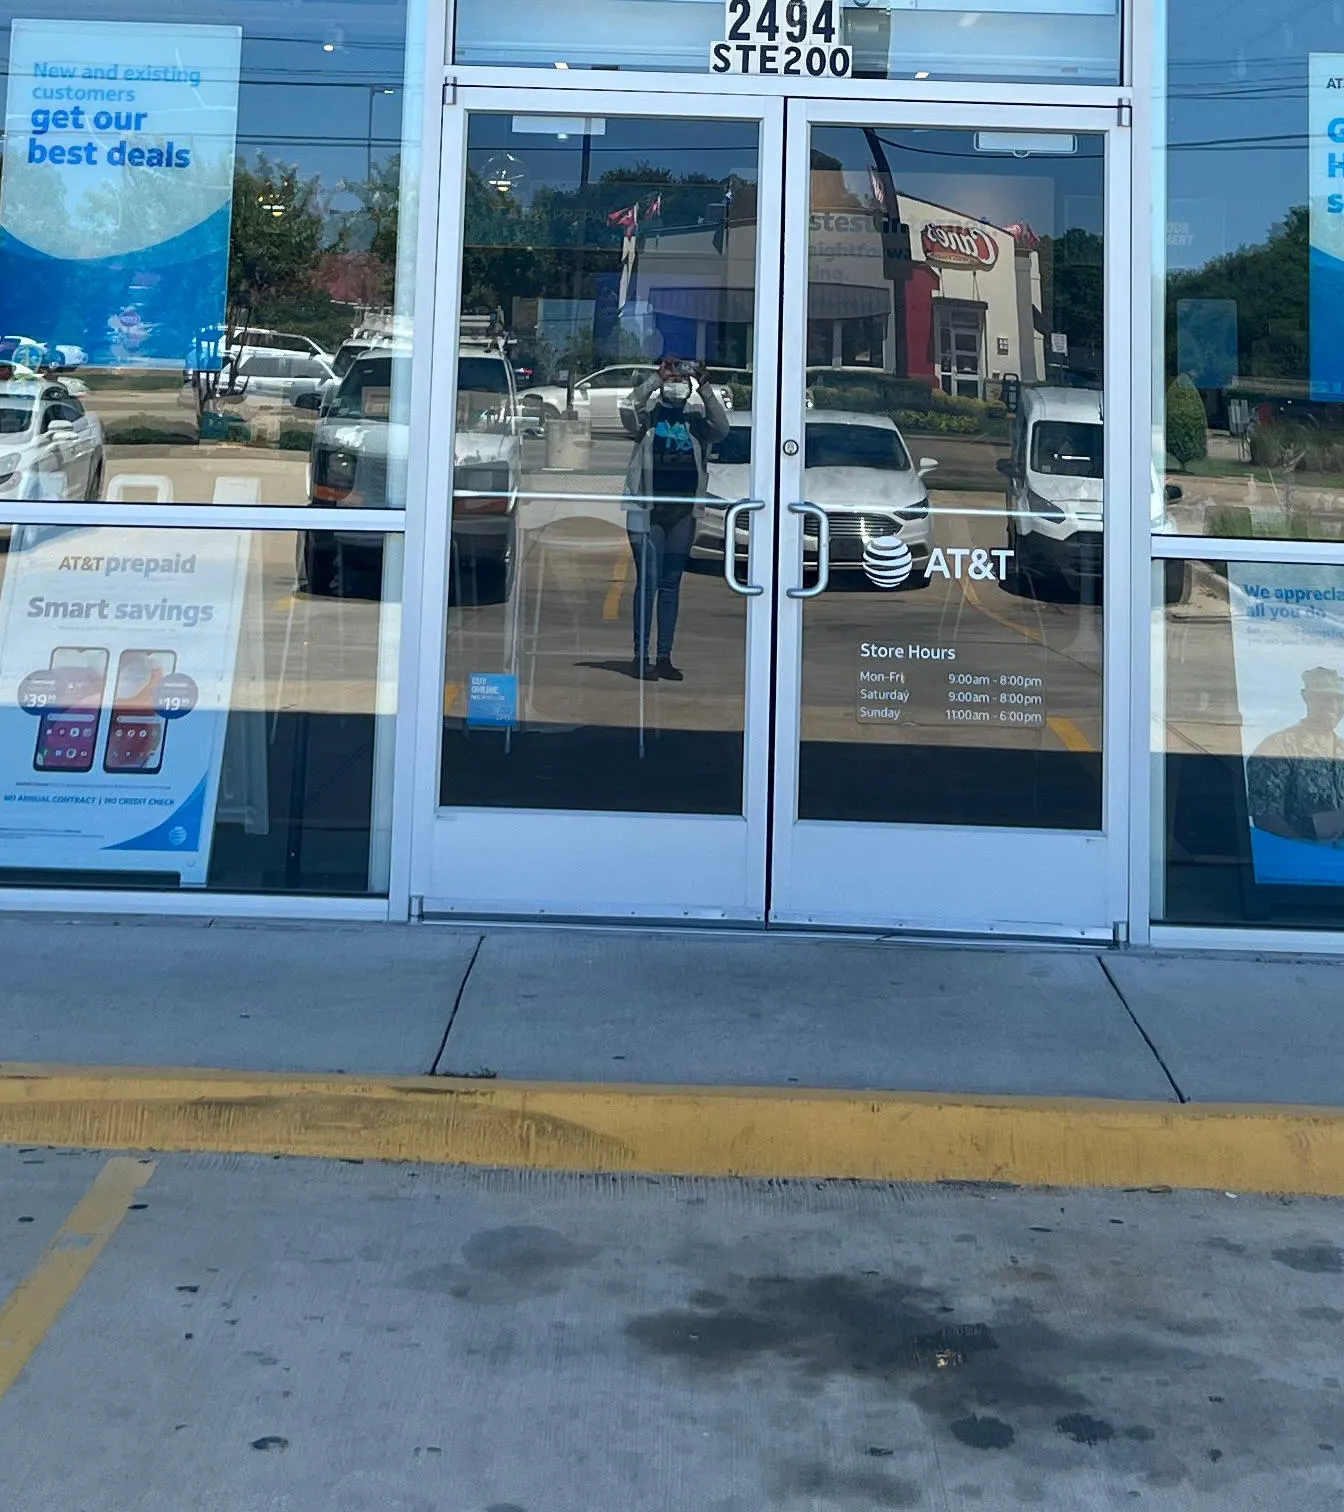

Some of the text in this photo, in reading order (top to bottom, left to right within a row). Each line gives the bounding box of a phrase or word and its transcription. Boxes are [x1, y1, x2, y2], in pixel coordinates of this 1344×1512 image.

[33, 62, 201, 87] New and existing
[32, 86, 136, 103] customers
[31, 106, 148, 135] get our
[28, 138, 191, 169] best deals
[58, 553, 197, 577] AT&T prepaid
[924, 547, 1015, 580] AT&T
[1244, 584, 1270, 600] We
[27, 596, 214, 627] Smart savings
[1246, 603, 1265, 618] all
[1270, 606, 1301, 621] you
[860, 643, 956, 660] Store Hours
[860, 671, 905, 684] Mon-Fri
[1000, 675, 1042, 687] 8:00pm
[860, 689, 909, 703] Saturday
[1000, 693, 1042, 705] 8:00pm
[860, 707, 900, 720] Sunday
[1000, 711, 1042, 723] 6:00pm
